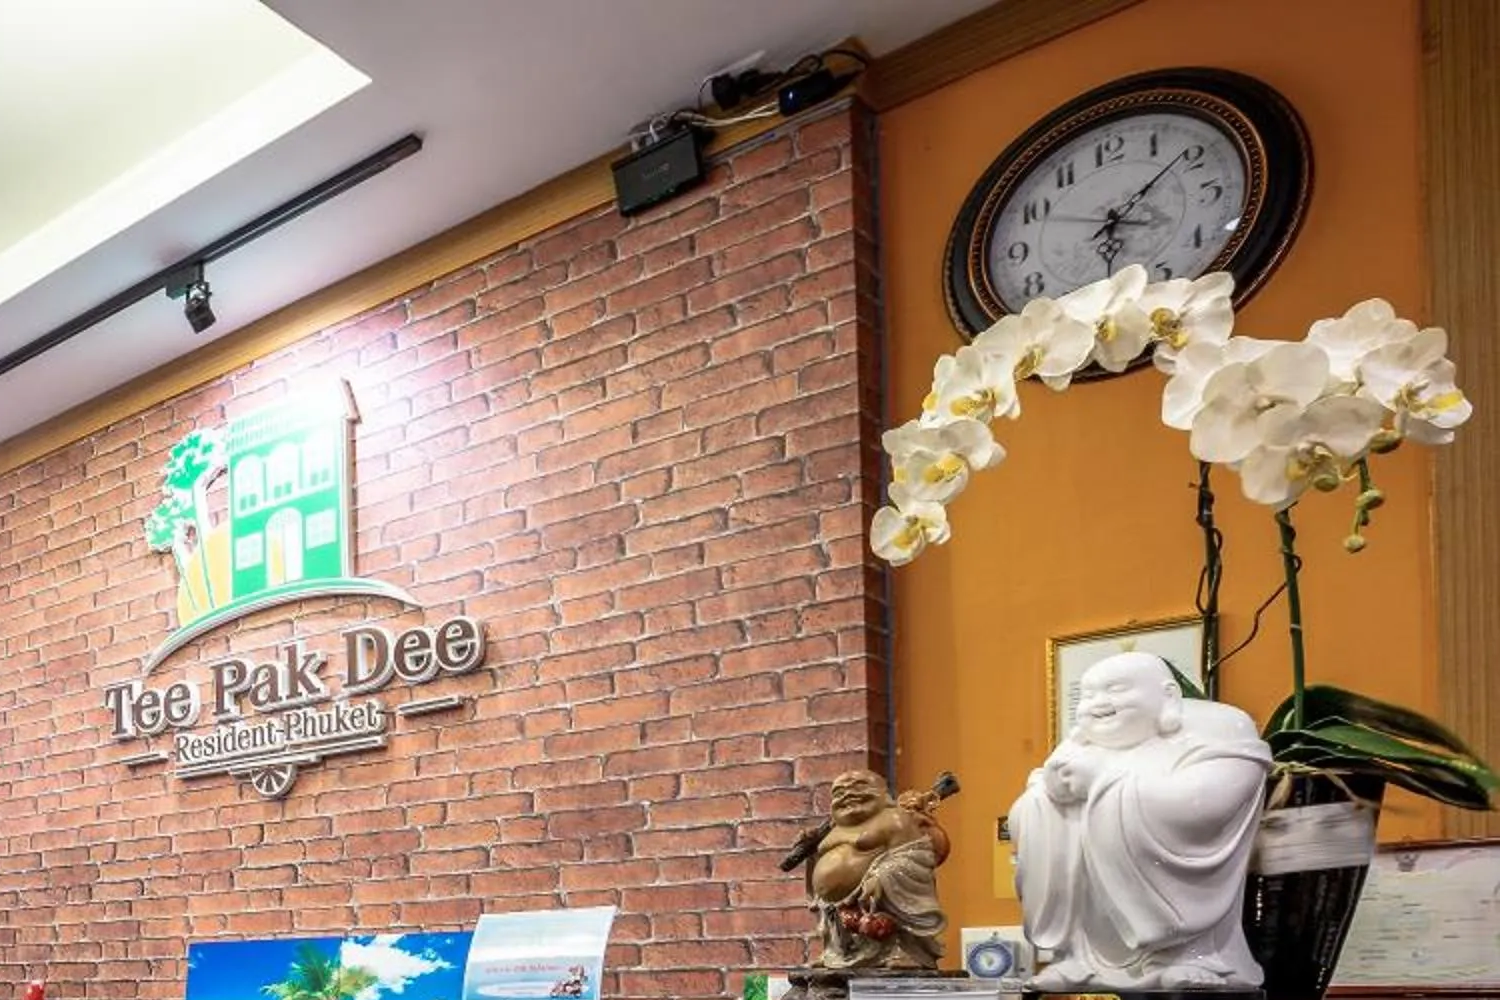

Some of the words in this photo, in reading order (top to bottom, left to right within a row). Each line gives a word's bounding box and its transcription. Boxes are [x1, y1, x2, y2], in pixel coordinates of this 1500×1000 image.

[1094, 133, 1125, 168] 12
[1149, 132, 1158, 158] 1
[1055, 160, 1076, 189] 11
[1023, 197, 1051, 225] 10
[1007, 241, 1029, 267] 9
[1023, 271, 1045, 298] 8
[104, 681, 196, 739] Tee
[210, 642, 324, 718] Pak
[341, 617, 481, 690] Dee
